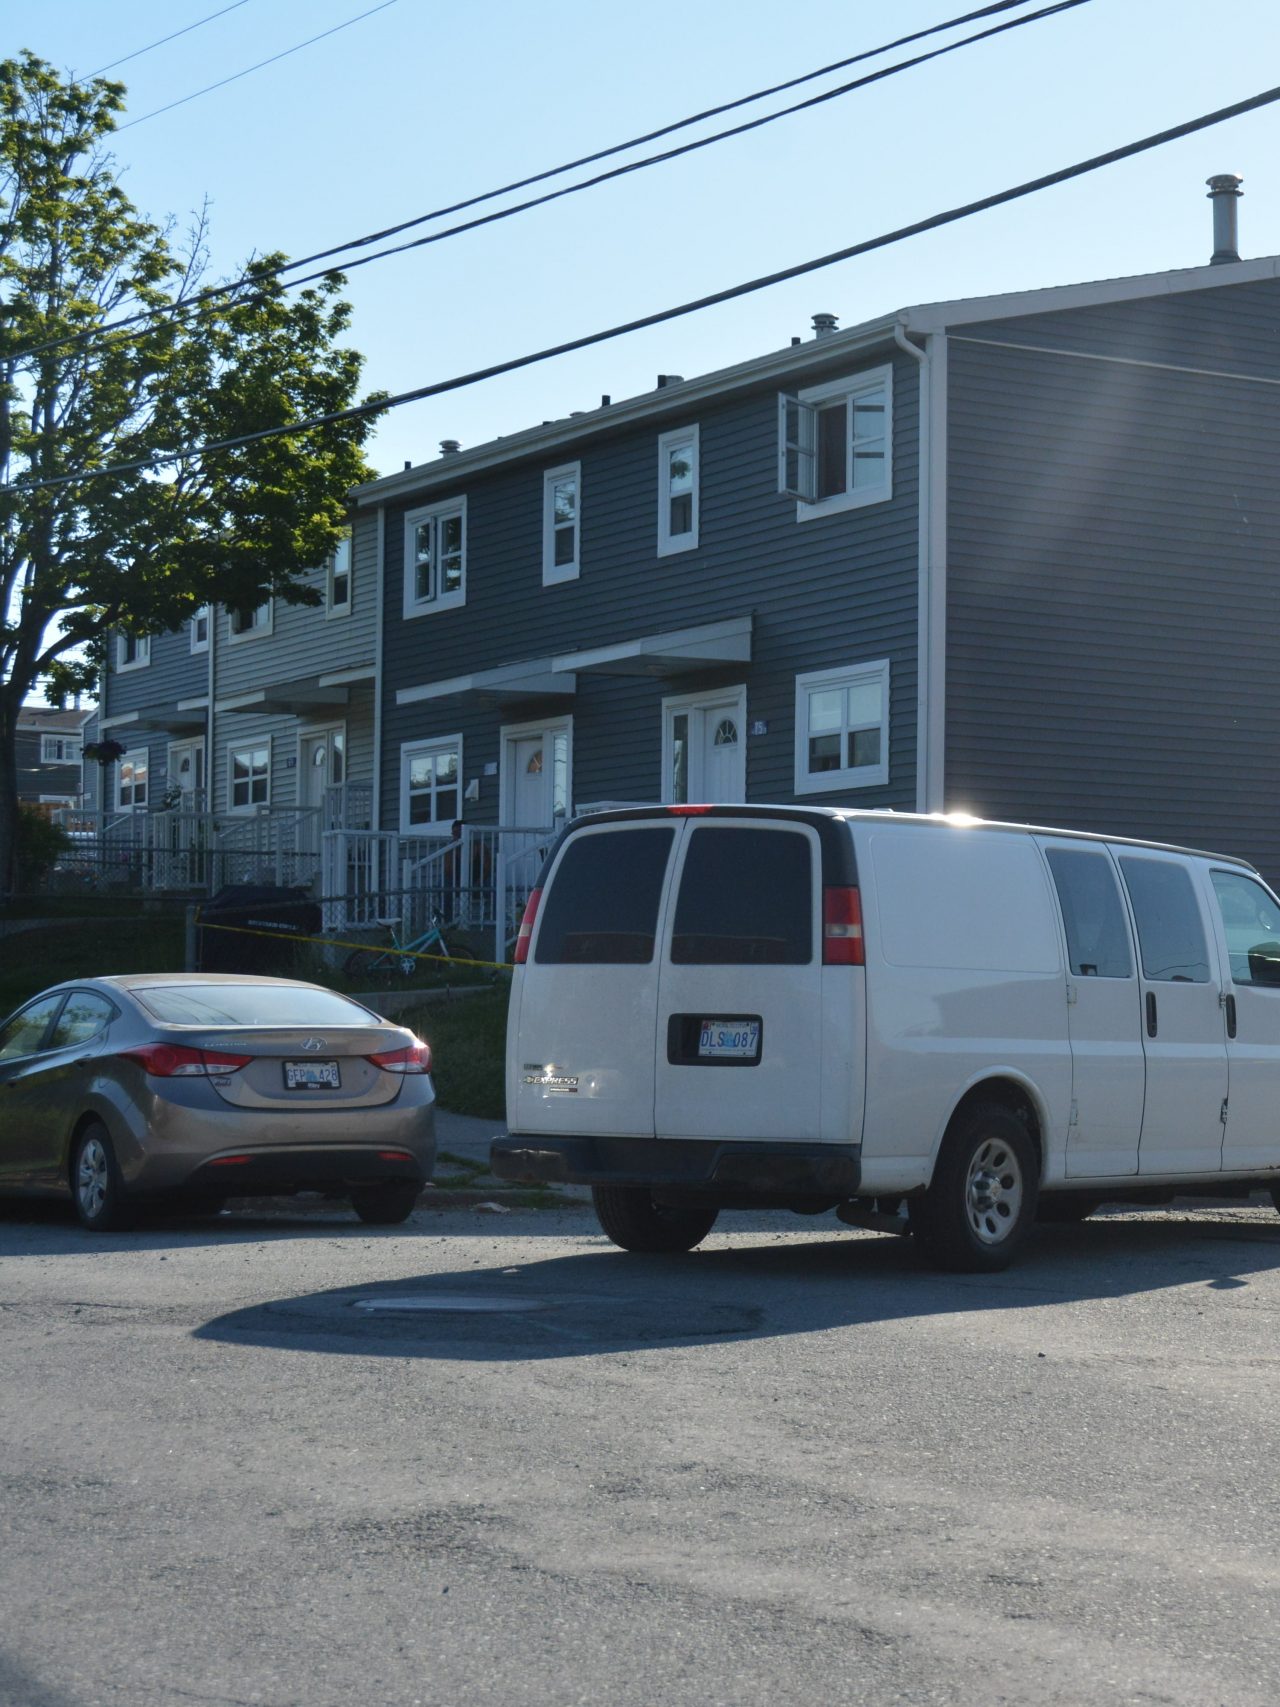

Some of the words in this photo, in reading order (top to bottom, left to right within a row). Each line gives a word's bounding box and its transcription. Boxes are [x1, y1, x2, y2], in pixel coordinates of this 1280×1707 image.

[701, 1031, 725, 1047] DLS
[734, 1031, 757, 1048] 087
[287, 1068, 305, 1082] GEP
[533, 1076, 577, 1085] EXPRESS
